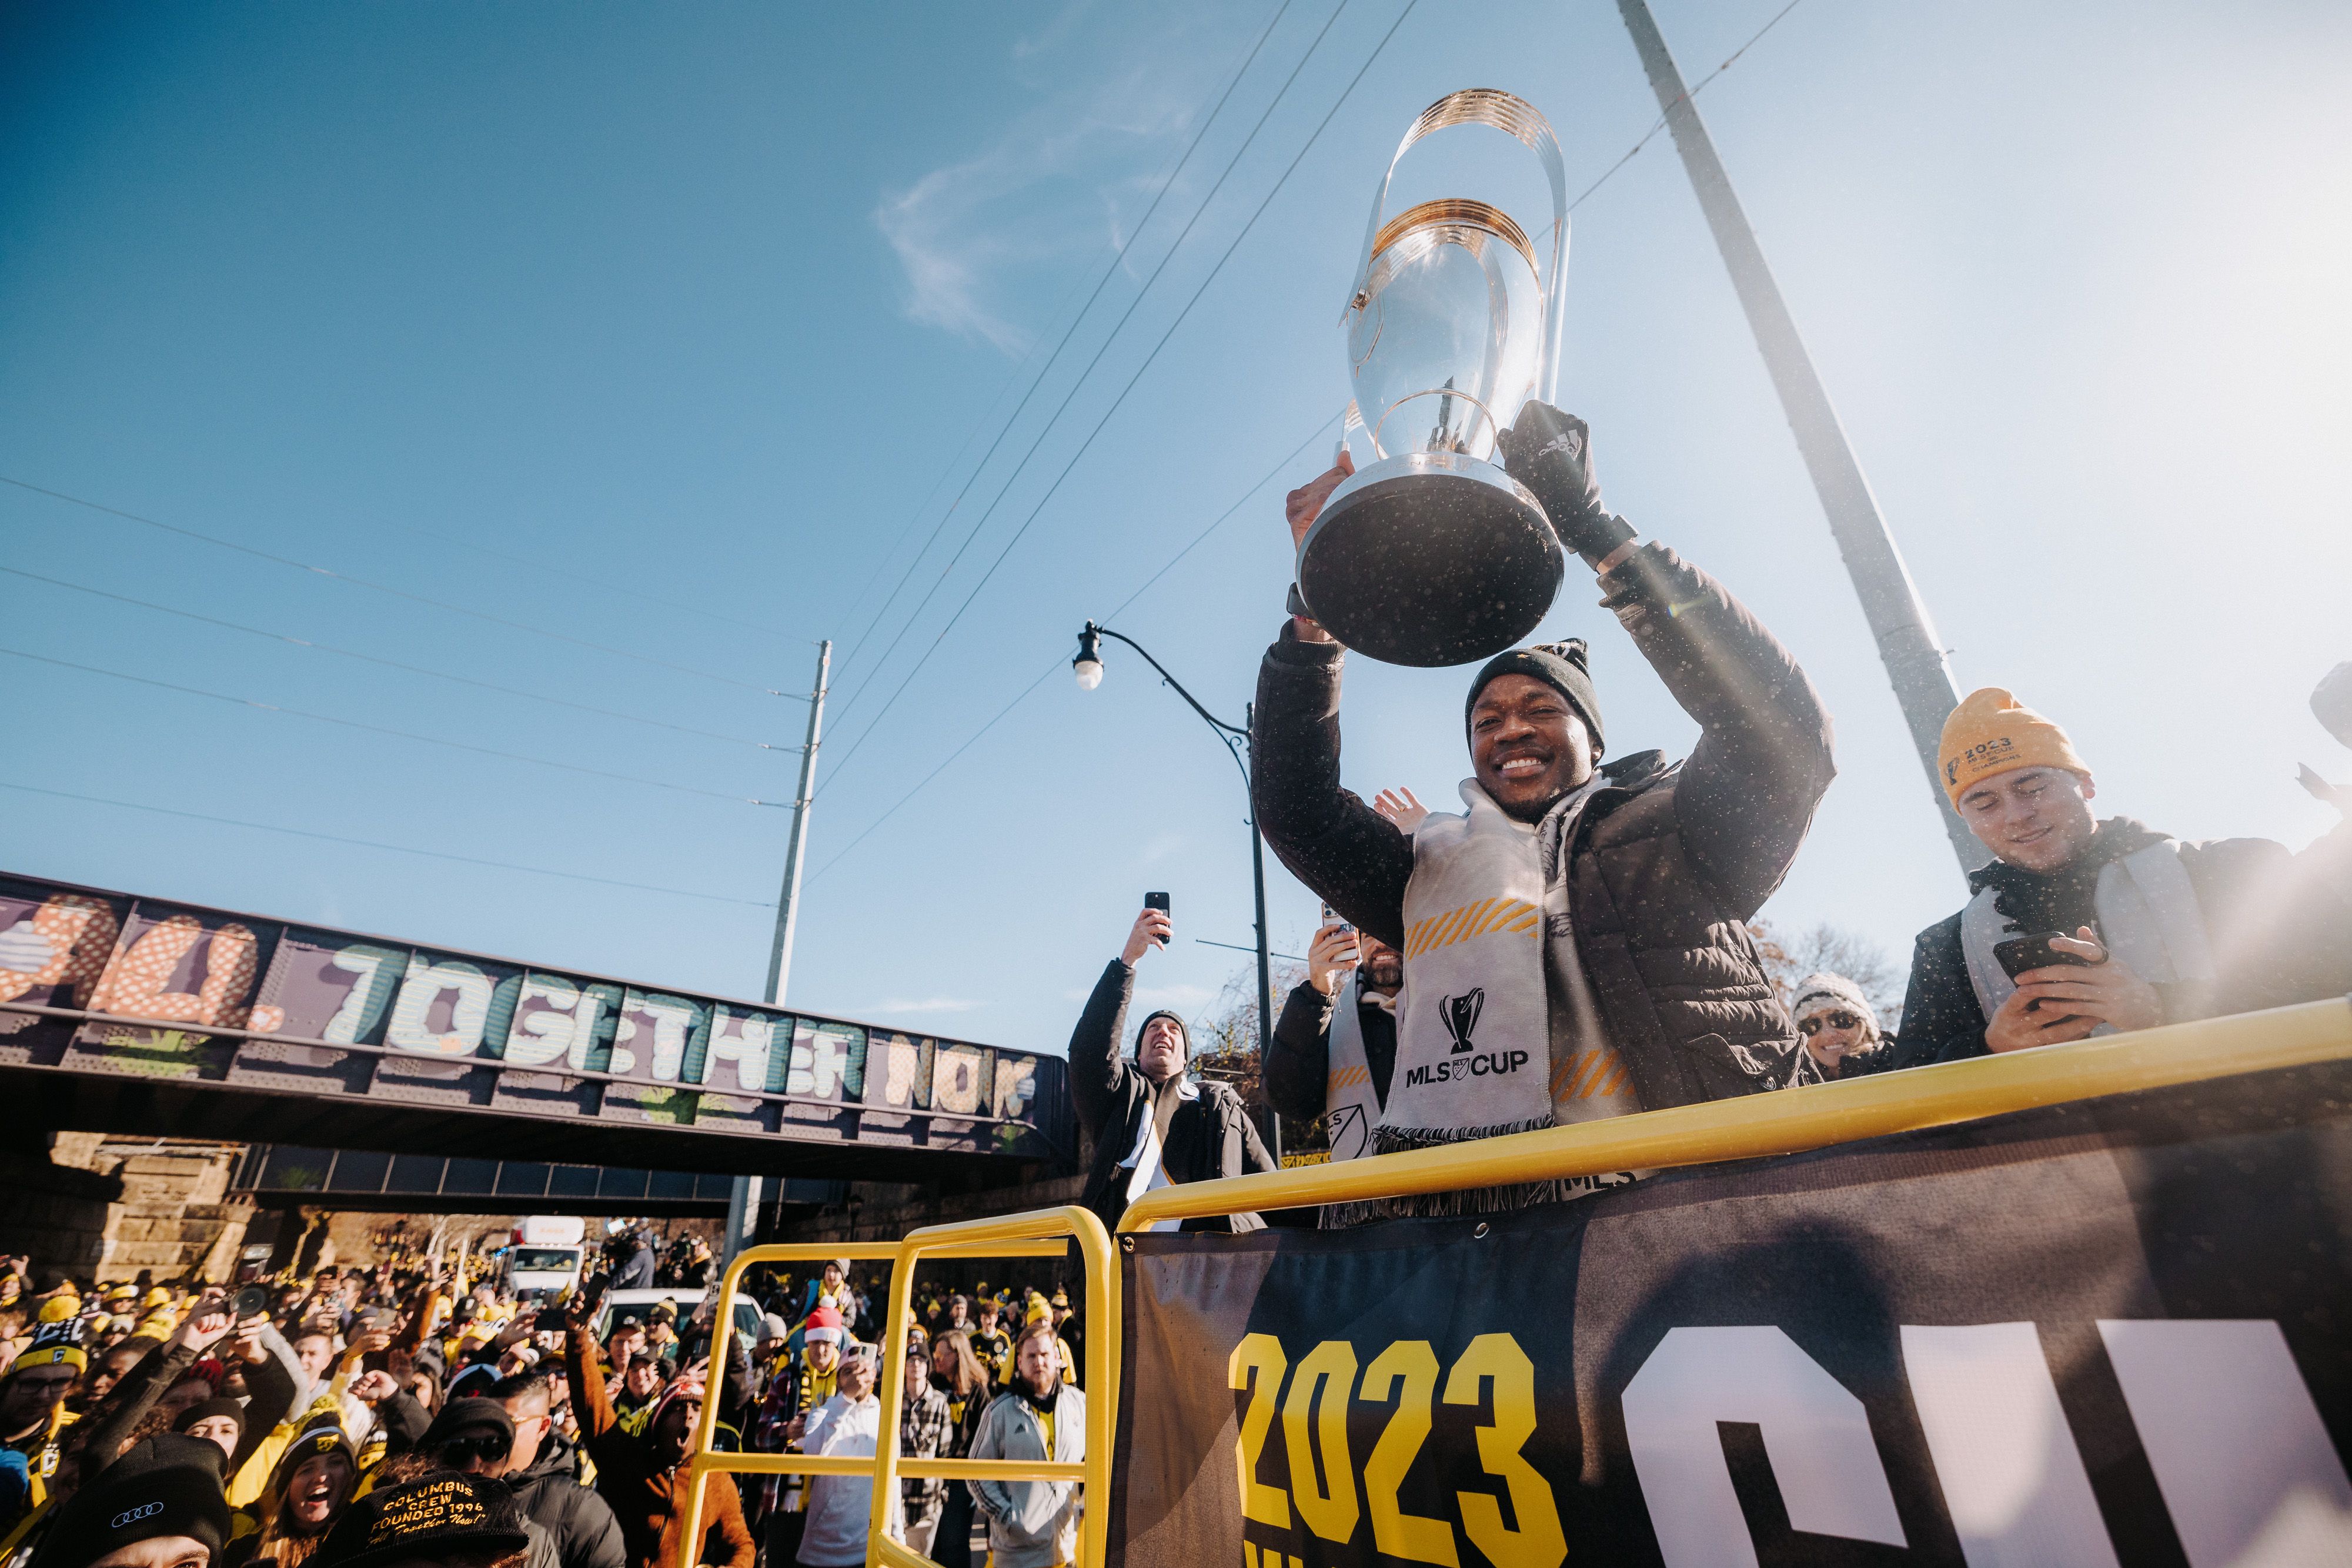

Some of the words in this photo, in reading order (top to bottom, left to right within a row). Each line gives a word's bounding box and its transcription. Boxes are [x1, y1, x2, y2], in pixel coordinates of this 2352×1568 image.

[1965, 737, 2012, 759] 2023
[323, 944, 868, 1099] TOGETHER
[1406, 1061, 1451, 1088] MLS
[1470, 1049, 1529, 1076] CUP
[1327, 1113, 1342, 1129] LS
[1228, 1332, 1569, 1568] 2023
[383, 1481, 473, 1511] COLUMBUS
[408, 1492, 453, 1510] CREW
[370, 1506, 444, 1534] FOUNDED
[449, 1502, 483, 1514] 1996
